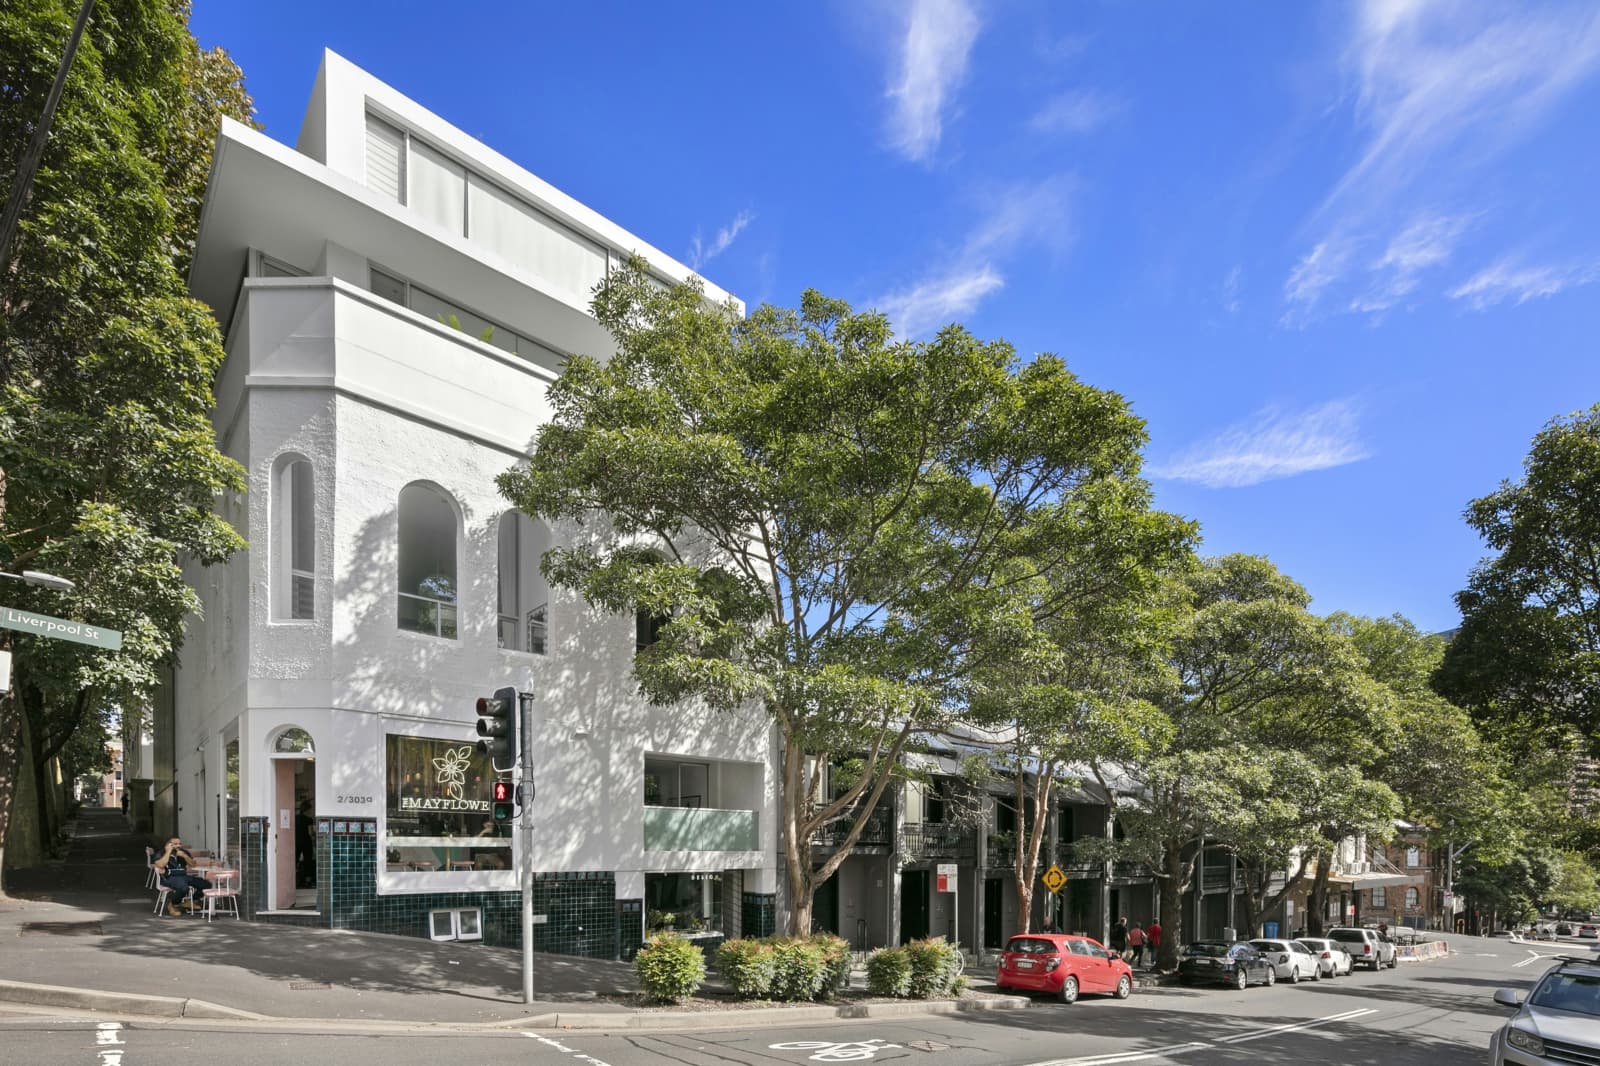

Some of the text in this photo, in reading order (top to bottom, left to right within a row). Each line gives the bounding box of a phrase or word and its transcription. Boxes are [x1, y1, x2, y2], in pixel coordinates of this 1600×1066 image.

[8, 611, 100, 640] Liverpool St
[409, 797, 491, 811] MAYFLOWE
